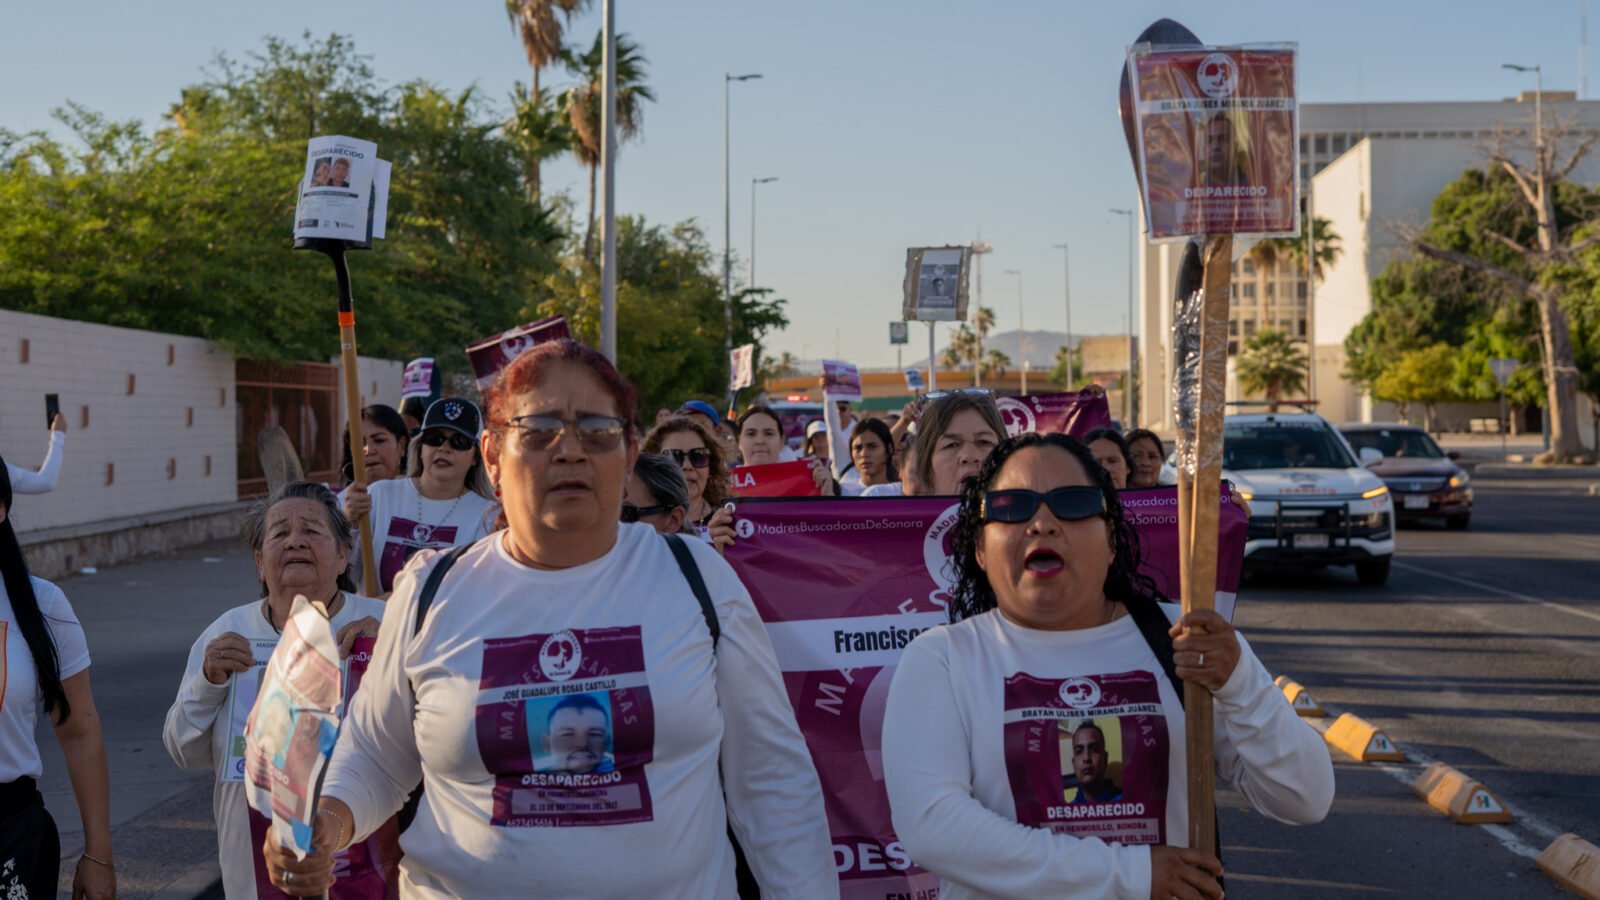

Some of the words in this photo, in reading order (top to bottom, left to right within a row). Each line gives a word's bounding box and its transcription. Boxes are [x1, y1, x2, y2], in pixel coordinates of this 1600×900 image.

[735, 473, 755, 487] LA
[757, 518, 924, 535] MadresBuscadorasDeSonora
[834, 626, 929, 654] Francisc
[521, 685, 561, 699] GUADALUPE
[562, 684, 584, 694] ROSAS
[585, 679, 617, 691] CASTILLO
[1022, 707, 1055, 718] BRAYAN
[1056, 708, 1085, 718] ULISES
[1087, 705, 1125, 717] MIRANDA
[521, 771, 622, 786] DESAPARECIDO
[1047, 803, 1145, 819] DESAPARECIDO
[1055, 825, 1065, 833] EN
[1117, 822, 1148, 831] SONORA
[1125, 835, 1138, 843] DEL
[832, 843, 919, 873] DES
